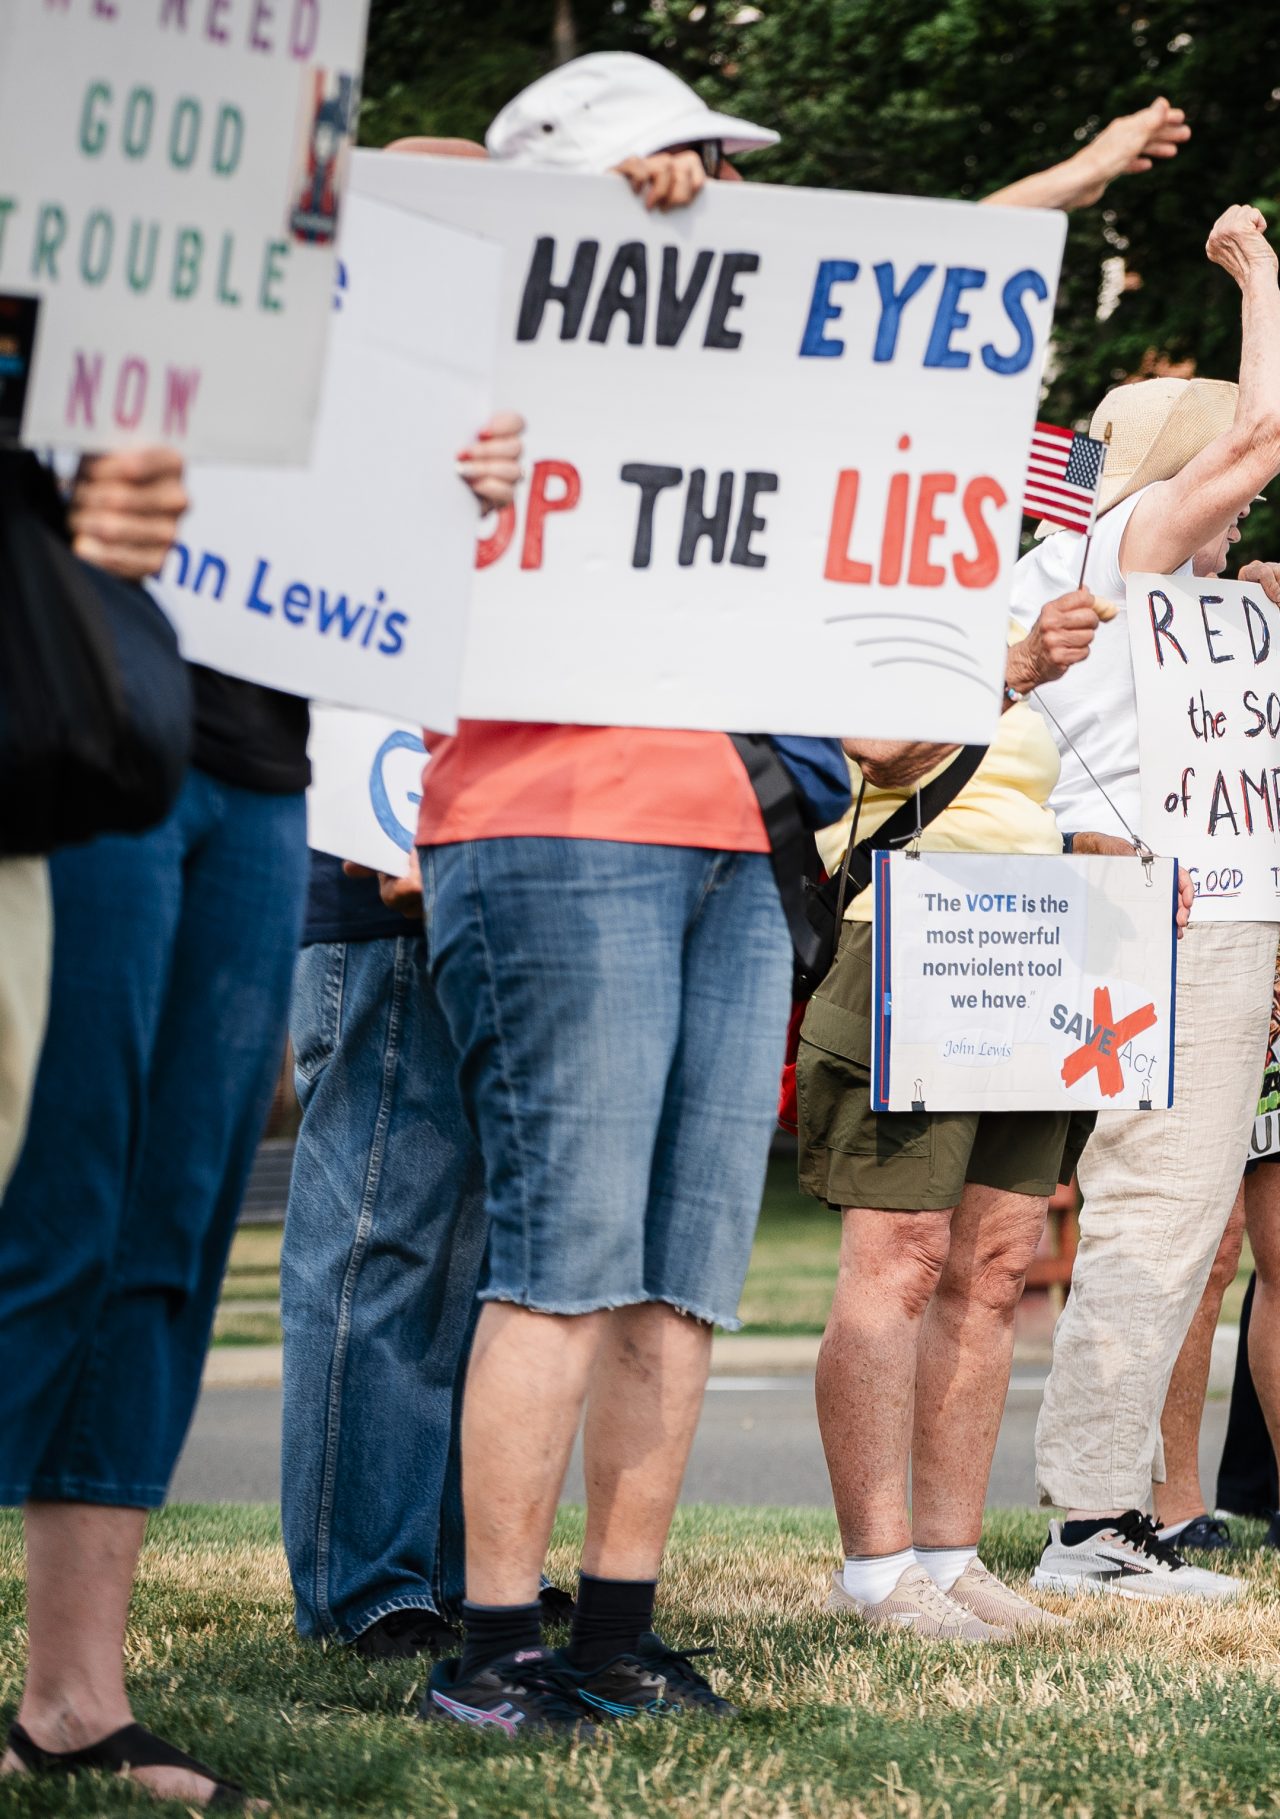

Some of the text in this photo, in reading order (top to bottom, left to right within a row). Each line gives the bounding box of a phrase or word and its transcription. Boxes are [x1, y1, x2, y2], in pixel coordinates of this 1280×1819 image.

[79, 79, 244, 178] GOOD
[515, 236, 1048, 376] HAVE EYES
[65, 350, 203, 437] NOW
[621, 463, 779, 569] THE
[246, 557, 409, 656] Lewis
[1187, 689, 1227, 742] the
[1163, 767, 1195, 817] of
[965, 894, 1017, 912] VOTE
[1022, 894, 1036, 913] is
[1040, 894, 1069, 913] the
[926, 926, 1060, 948] most powerful
[922, 957, 1062, 976] nonviolent tool
[951, 994, 977, 1008] we
[943, 1037, 1013, 1057] John Lewis
[1050, 1003, 1116, 1056] SAVE
